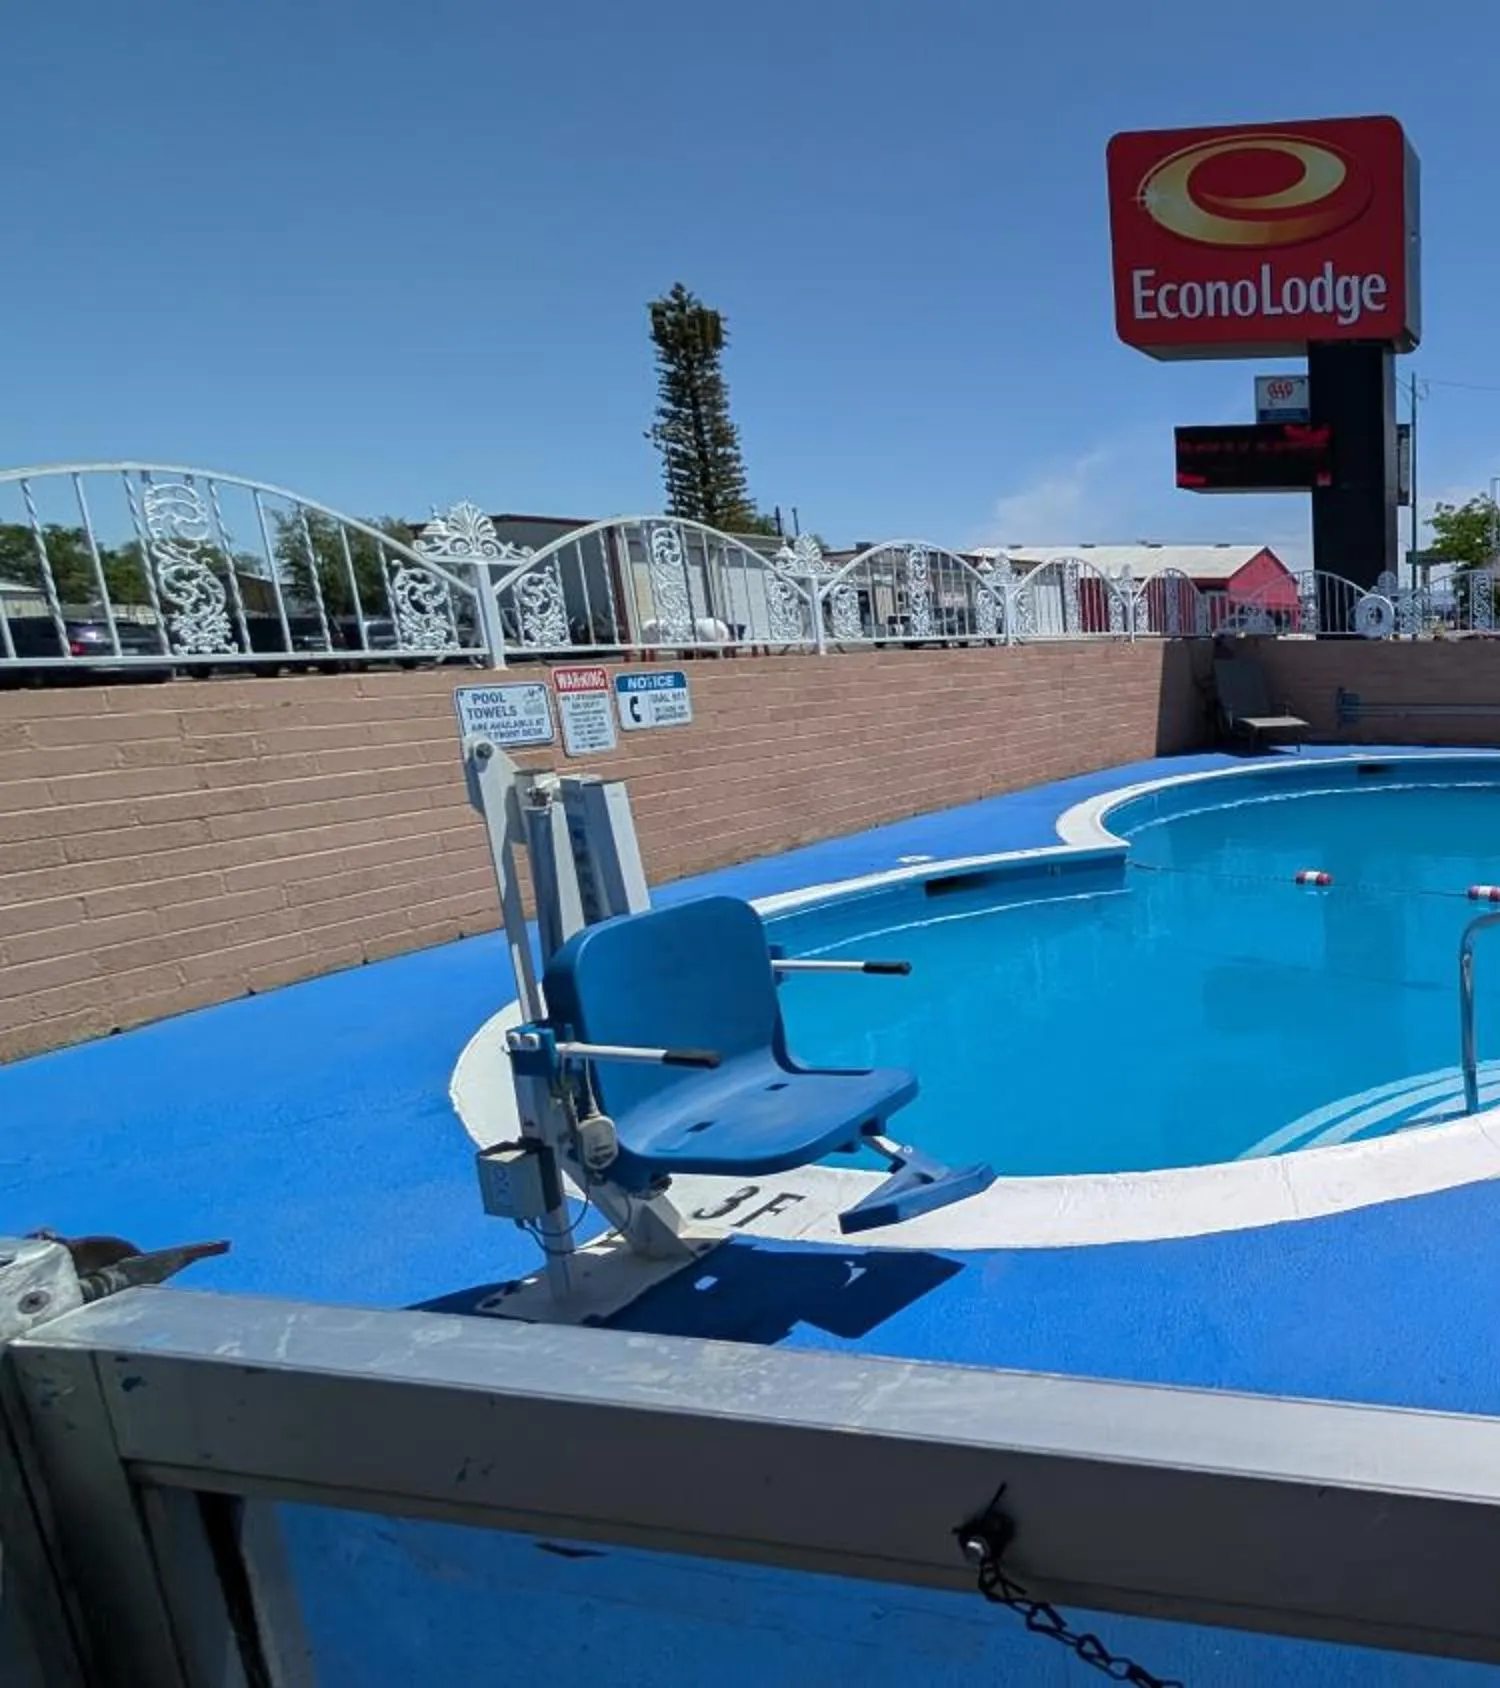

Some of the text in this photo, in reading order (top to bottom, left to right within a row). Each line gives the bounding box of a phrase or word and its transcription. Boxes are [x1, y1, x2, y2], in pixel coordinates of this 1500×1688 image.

[1132, 261, 1388, 325] EconoLodge
[471, 691, 507, 705] POOL
[466, 705, 518, 720] TOWELS
